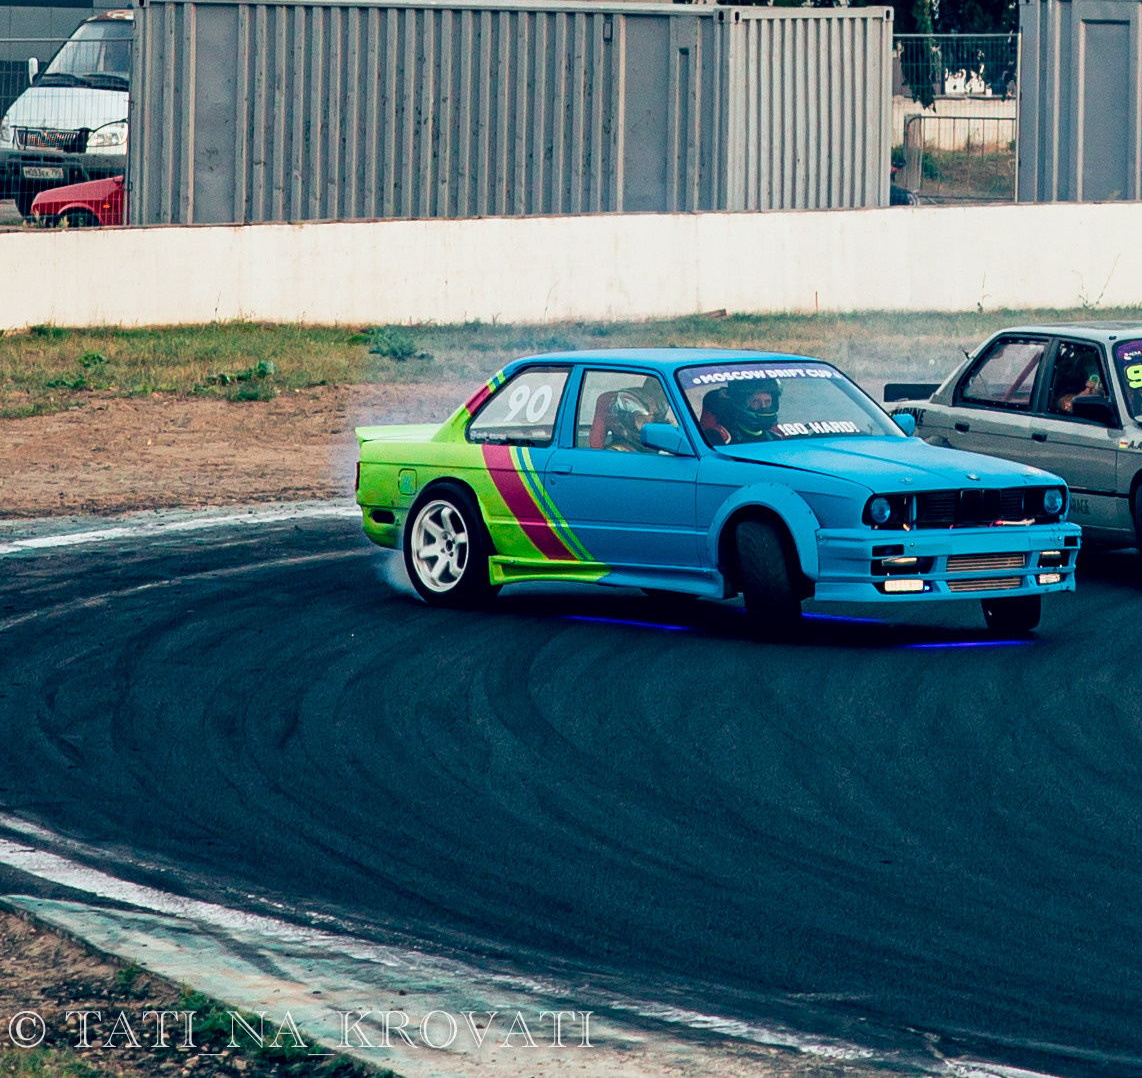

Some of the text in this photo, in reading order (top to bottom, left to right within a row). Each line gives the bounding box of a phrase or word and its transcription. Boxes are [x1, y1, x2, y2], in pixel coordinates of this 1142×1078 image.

[699, 367, 833, 385] MOSCOW DRIFT CUP
[503, 384, 553, 423] 90
[776, 420, 861, 437] !GO HARD!
